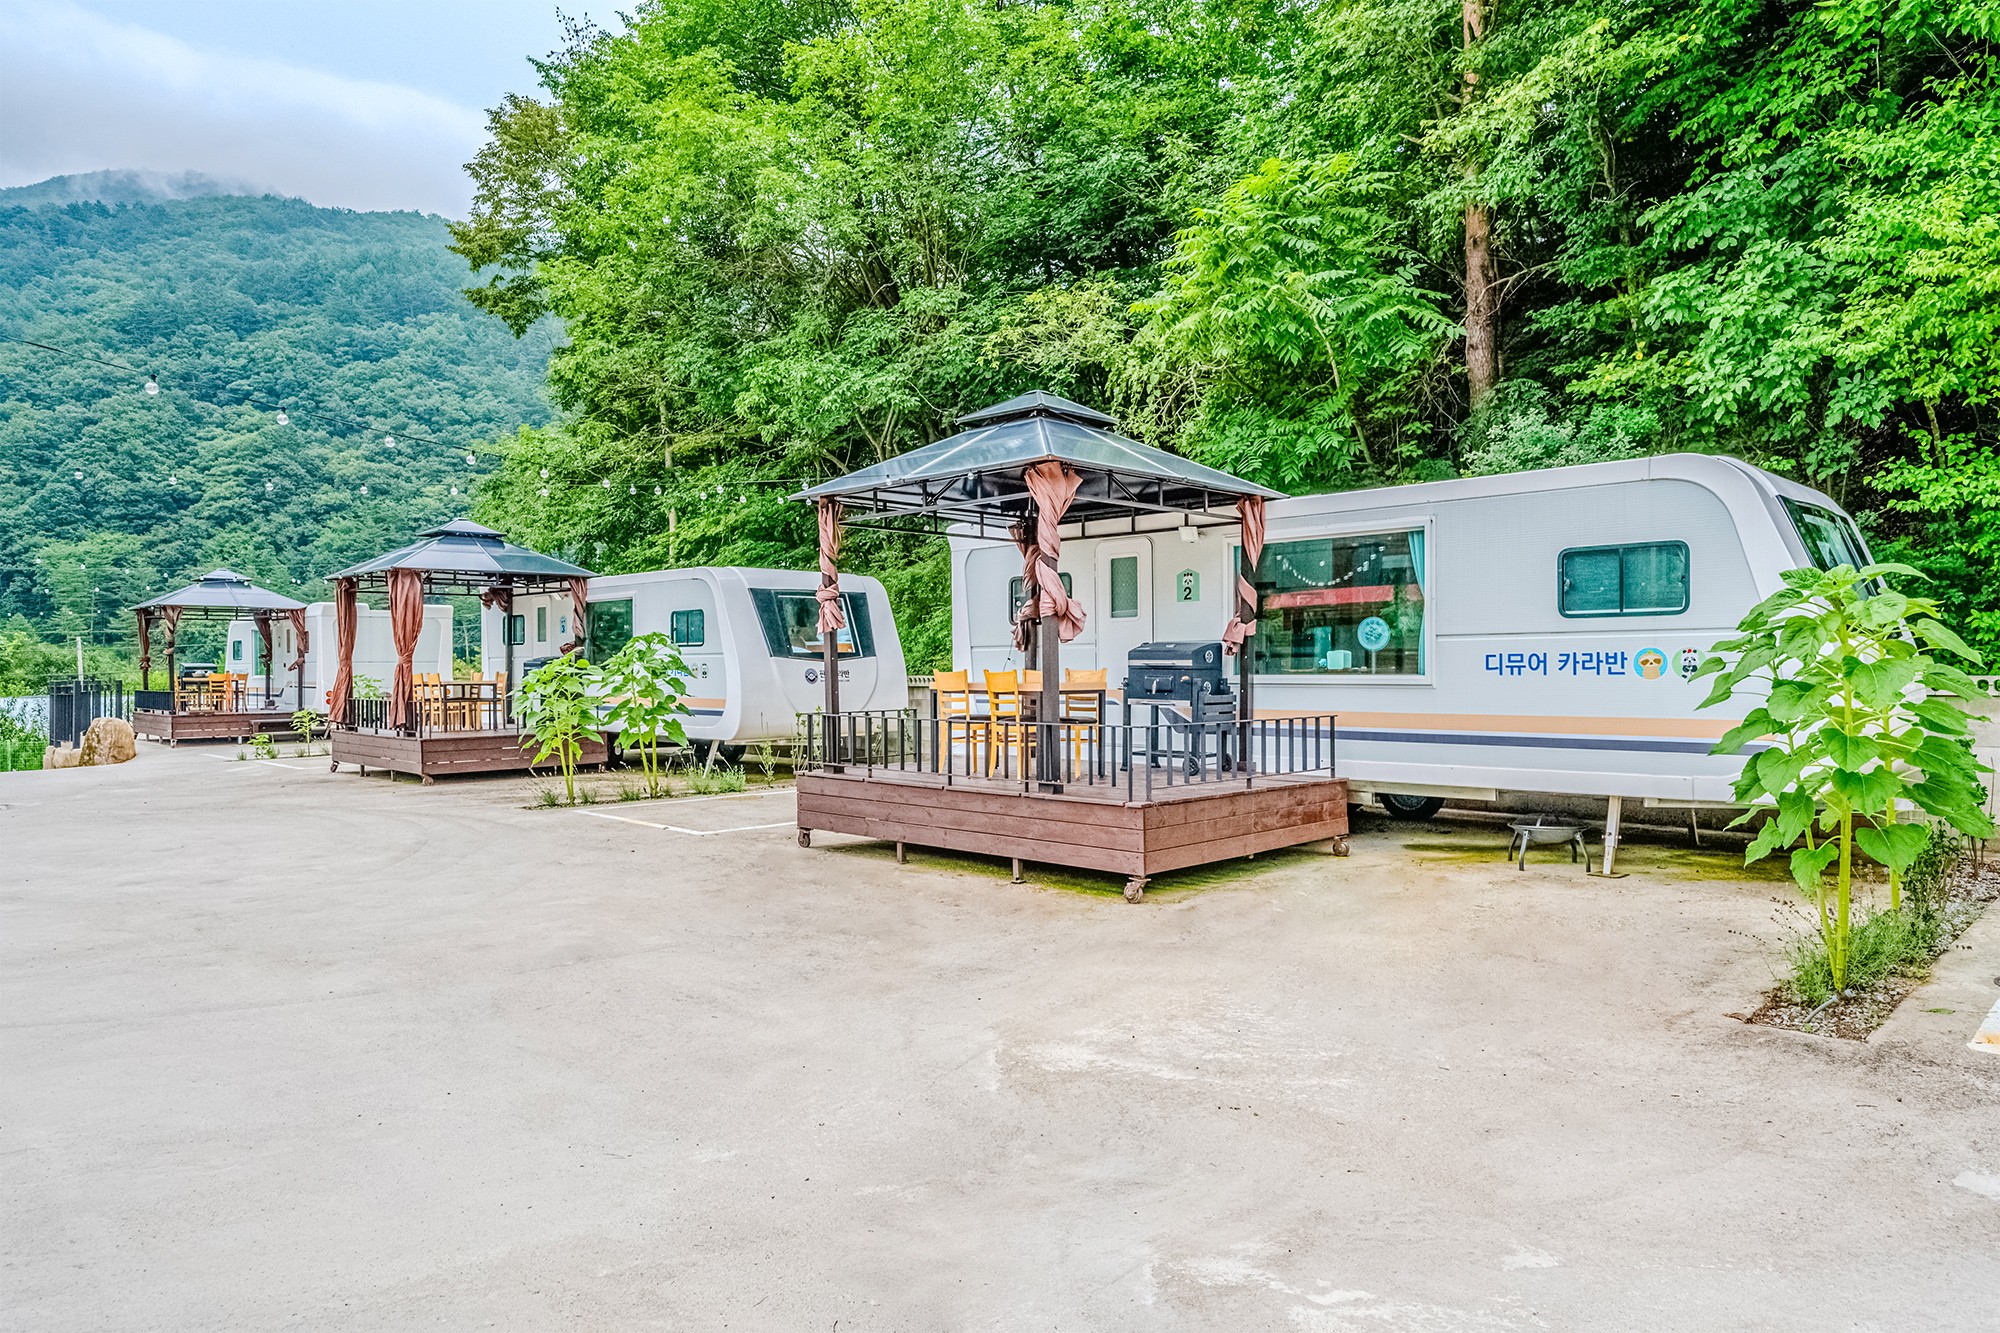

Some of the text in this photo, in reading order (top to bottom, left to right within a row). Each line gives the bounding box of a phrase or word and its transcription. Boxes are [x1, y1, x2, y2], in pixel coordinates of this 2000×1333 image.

[1183, 586, 1192, 600] 2
[1485, 651, 1628, 676] 디뮤어 카라반
